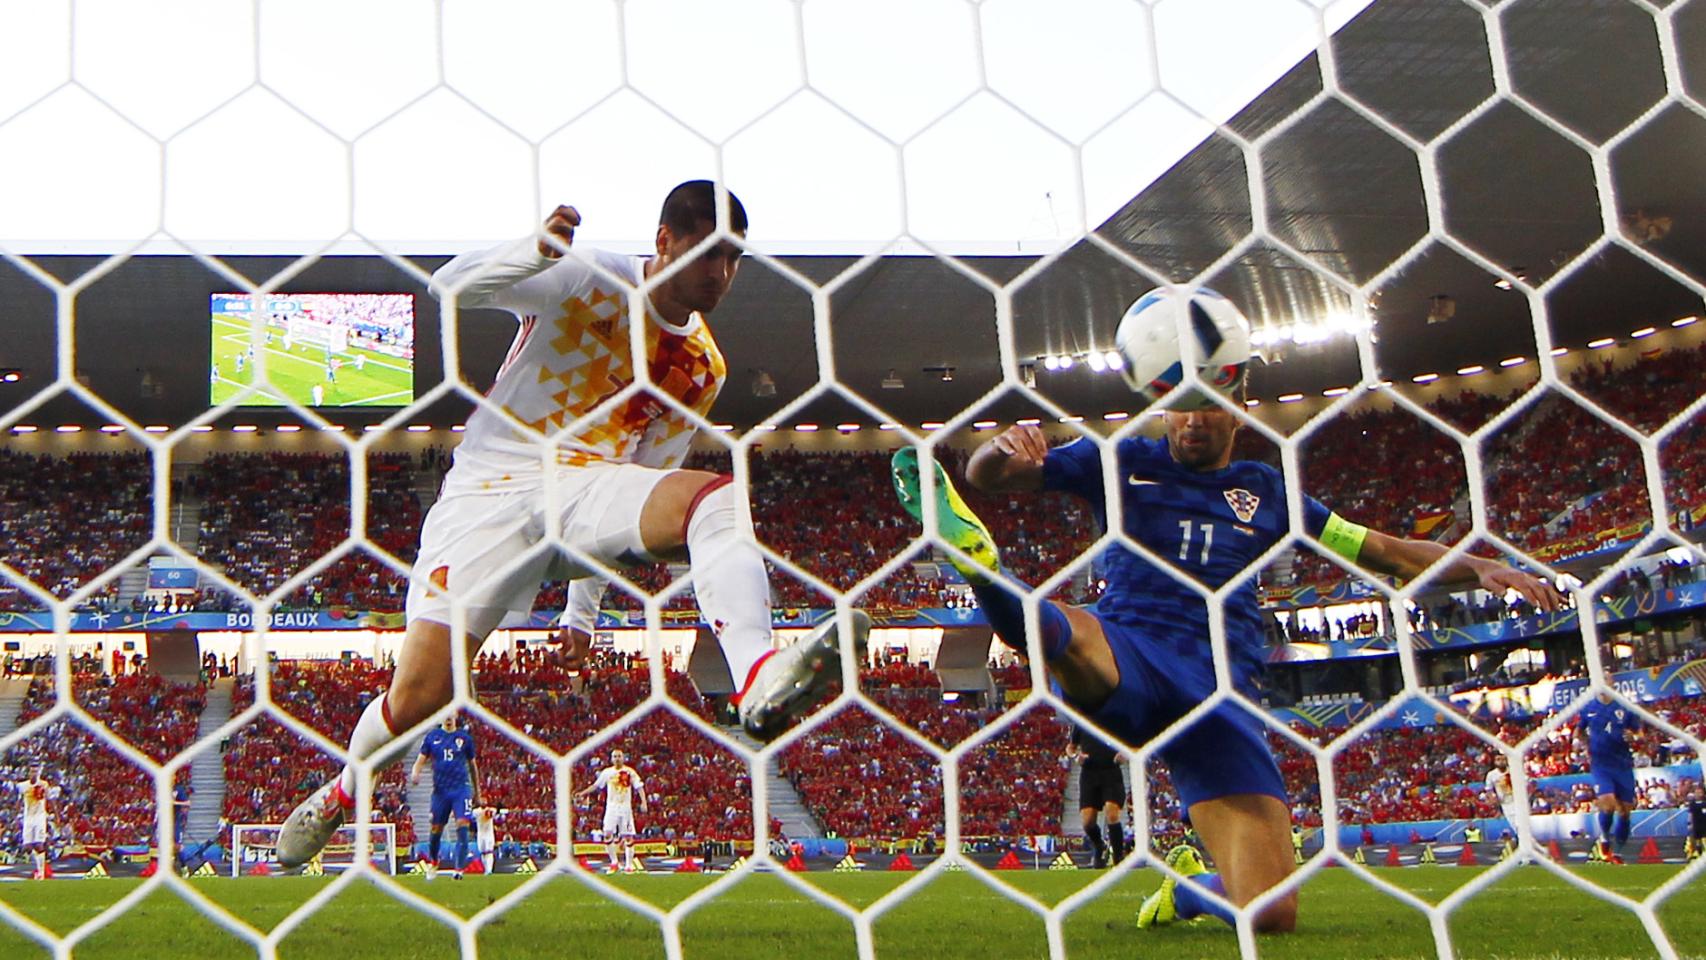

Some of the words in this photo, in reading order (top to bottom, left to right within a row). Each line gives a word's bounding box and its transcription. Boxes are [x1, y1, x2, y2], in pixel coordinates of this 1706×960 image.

[1179, 519, 1214, 566] 11
[226, 613, 319, 627] BODEAUX
[1613, 679, 1646, 696] 2016
[1604, 721, 1613, 734] 4
[443, 748, 454, 761] 15
